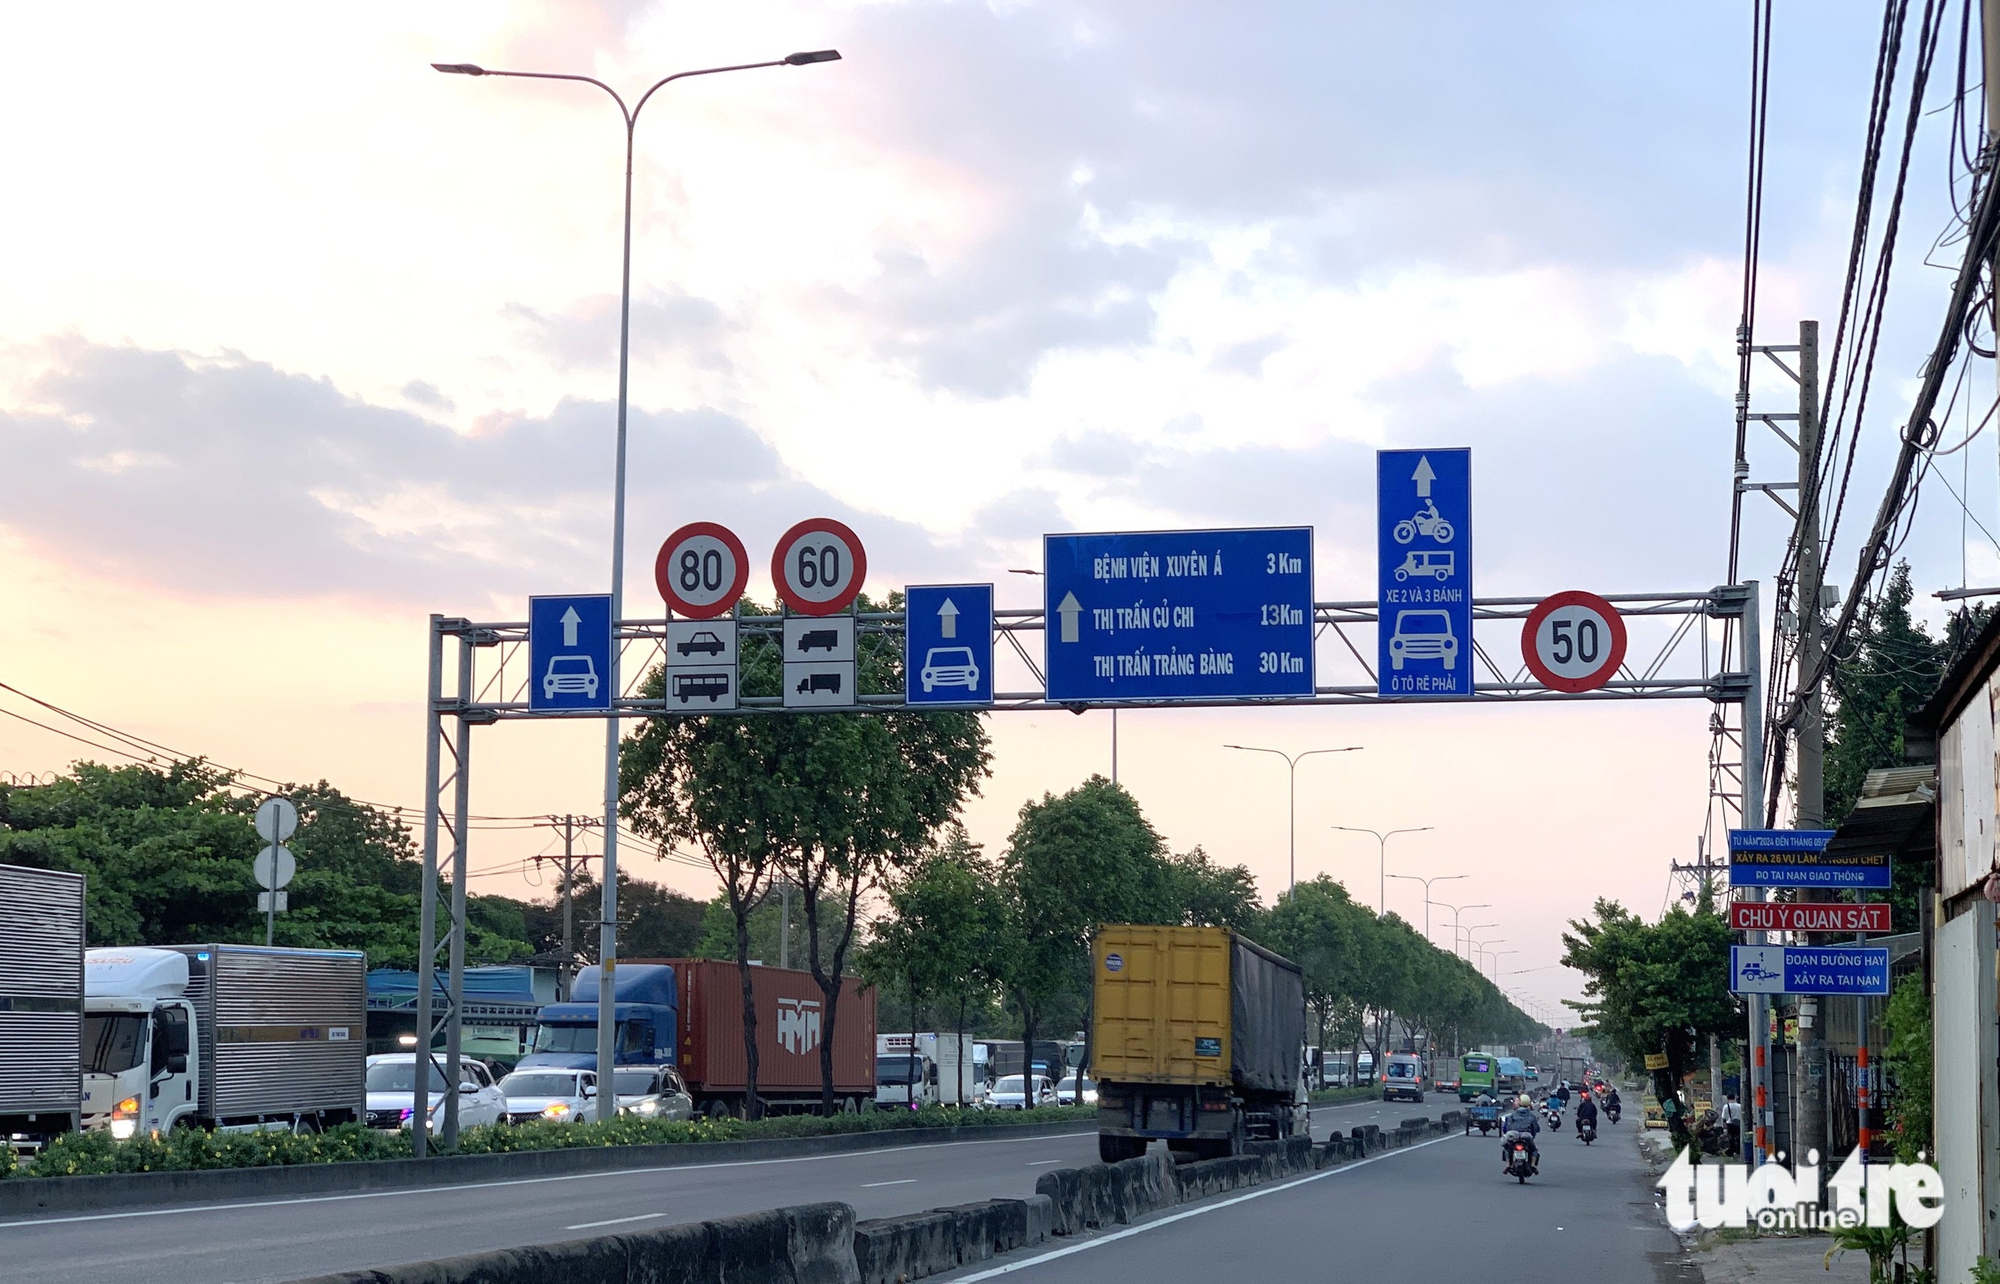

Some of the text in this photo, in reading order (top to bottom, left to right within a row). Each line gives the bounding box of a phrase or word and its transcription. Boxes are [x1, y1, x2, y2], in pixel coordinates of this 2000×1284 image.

[680, 549, 722, 591] 80
[799, 545, 839, 588] 60
[1093, 549, 1302, 584] BỆNH VIỆN XUYÊN Á 3 Km
[1386, 585, 1462, 603] XE 2 VÀ 3 BÁNH
[1093, 607, 1114, 635] THỊ
[1116, 599, 1150, 629] TRẤN
[1152, 598, 1170, 628] CỦ
[1173, 606, 1195, 628] CHI
[1552, 618, 1598, 664] 50
[1093, 646, 1303, 683] THỊ TRẤN TRẢNG BÀNG 30 Km
[1391, 672, 1456, 691] Ô TÔ RẼ PHẢI
[1759, 837, 1774, 847] 2024
[1775, 833, 1789, 847] ĐẾN
[1790, 836, 1813, 847] THÁNG
[1735, 850, 1753, 863] XẢY
[1756, 854, 1769, 863] RA
[1770, 853, 1781, 863] 26
[1783, 853, 1795, 865] VỤ
[1797, 850, 1818, 863] LÀM
[1771, 871, 1784, 880] TAI
[1787, 871, 1807, 883] NẠN
[1809, 871, 1831, 881] GIAO
[1833, 869, 1865, 882] THÔNG
[1738, 905, 1881, 929] CHÚ Ý QUAN SÁT
[1785, 952, 1885, 967] ĐOẠN ĐƯỜNG HAY
[1794, 971, 1880, 988] XẢY RA TAI NẠN
[777, 998, 820, 1056] HMM
